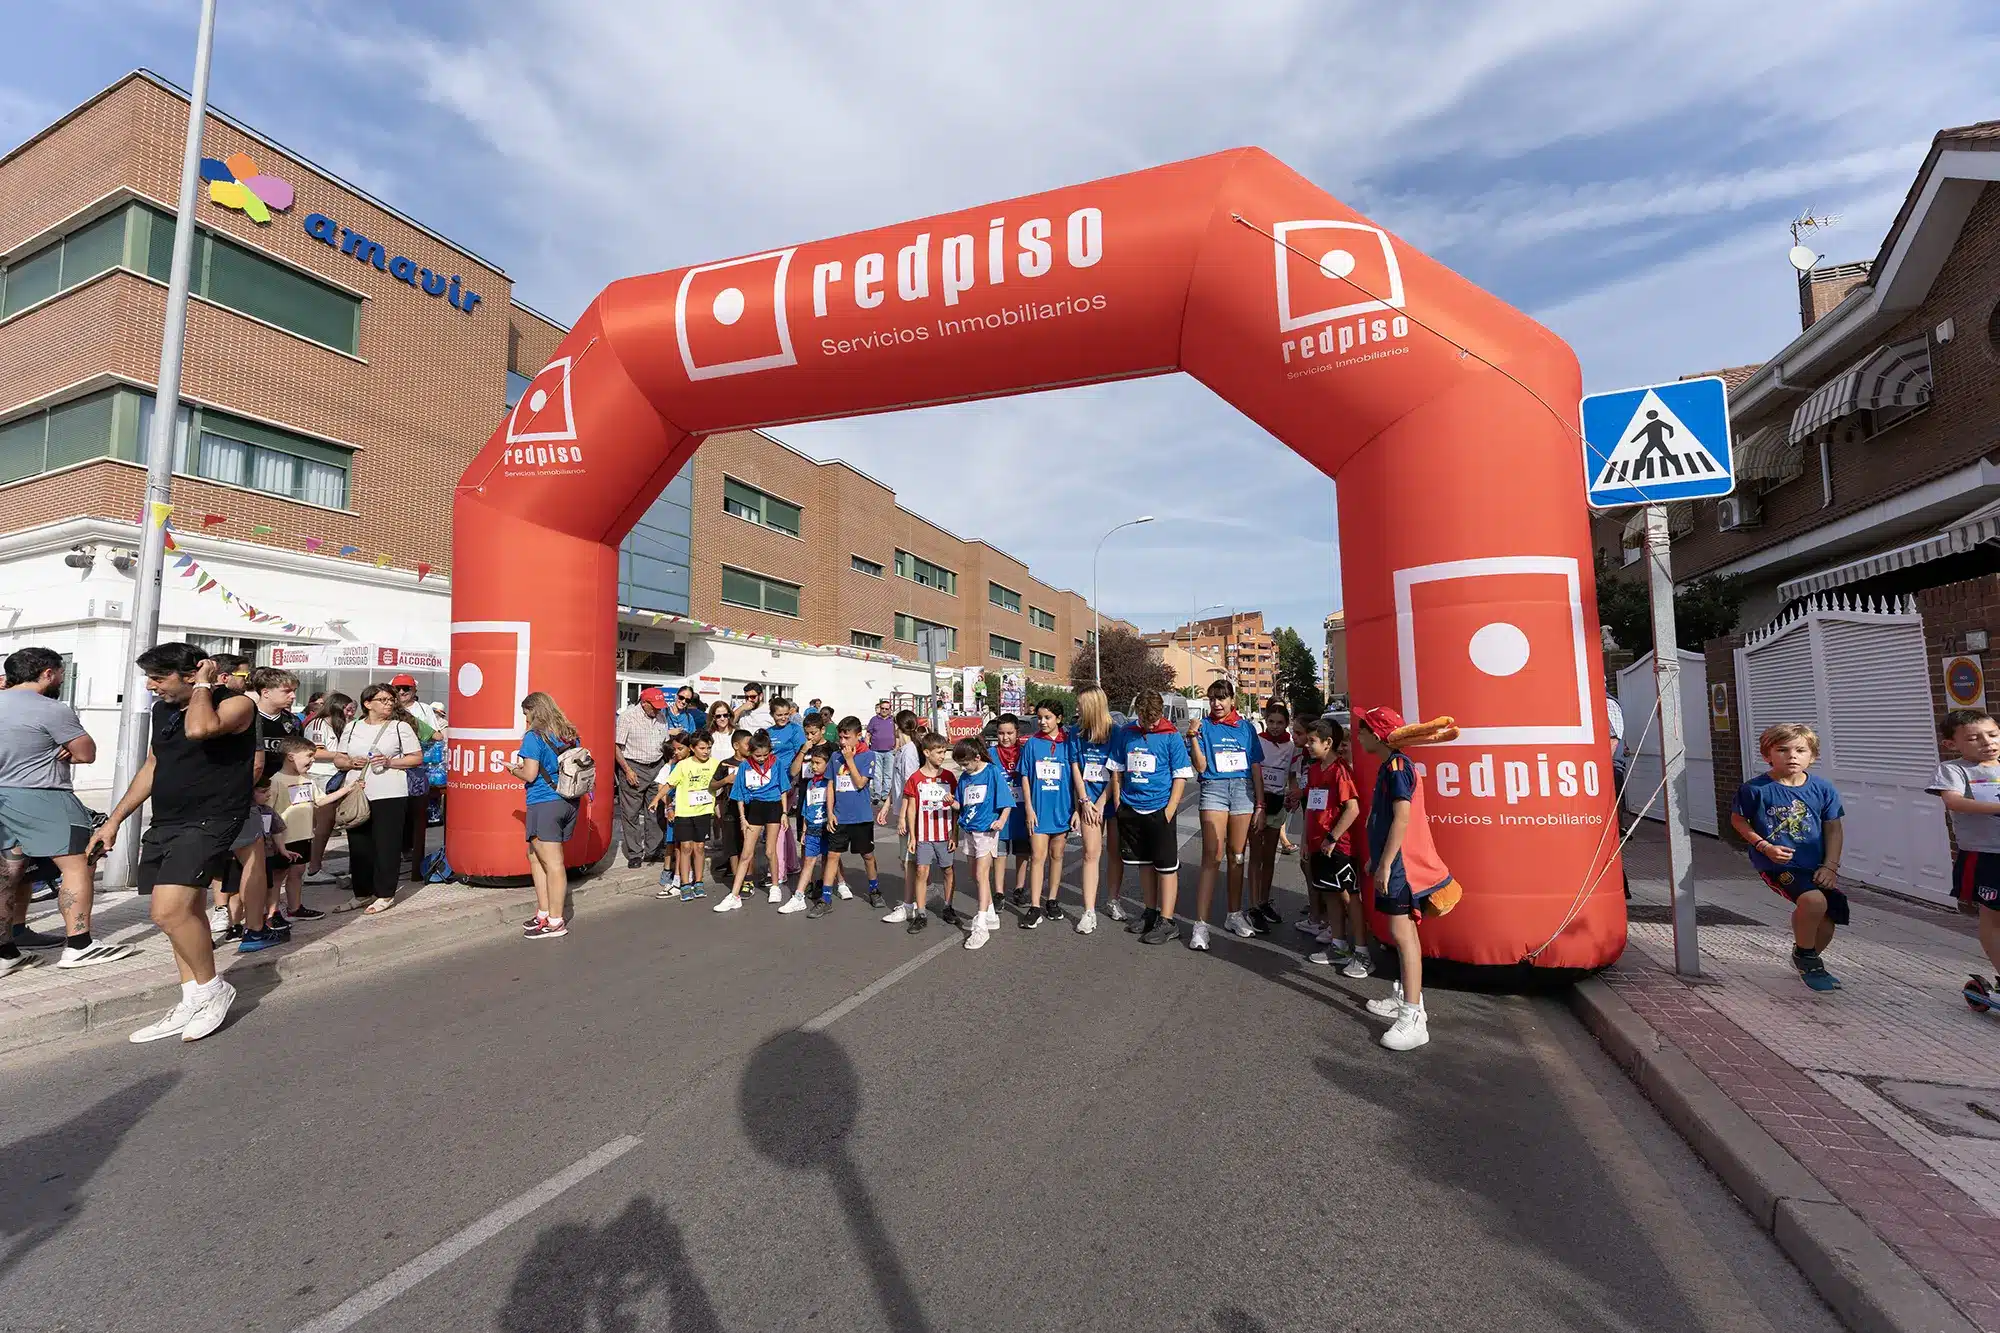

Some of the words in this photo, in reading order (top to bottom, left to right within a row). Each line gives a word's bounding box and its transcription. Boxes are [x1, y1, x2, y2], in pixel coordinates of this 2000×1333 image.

[303, 212, 482, 314] amavir
[813, 207, 1103, 318] redpiso
[821, 324, 930, 356] Servicios
[937, 294, 1107, 338] Inmobiliarios
[1282, 315, 1409, 364] redpiso
[1287, 363, 1333, 380] Servicios
[1336, 346, 1410, 368] Inmobiliarios
[504, 443, 583, 467] redpiso
[619, 627, 641, 643] vir
[398, 656, 443, 667] ALCORCÓN
[447, 744, 525, 777] edpiso
[460, 782, 525, 791] Inmobiliarios
[1424, 813, 1493, 825] ervicios
[1499, 813, 1603, 826] Inmobiliarios
